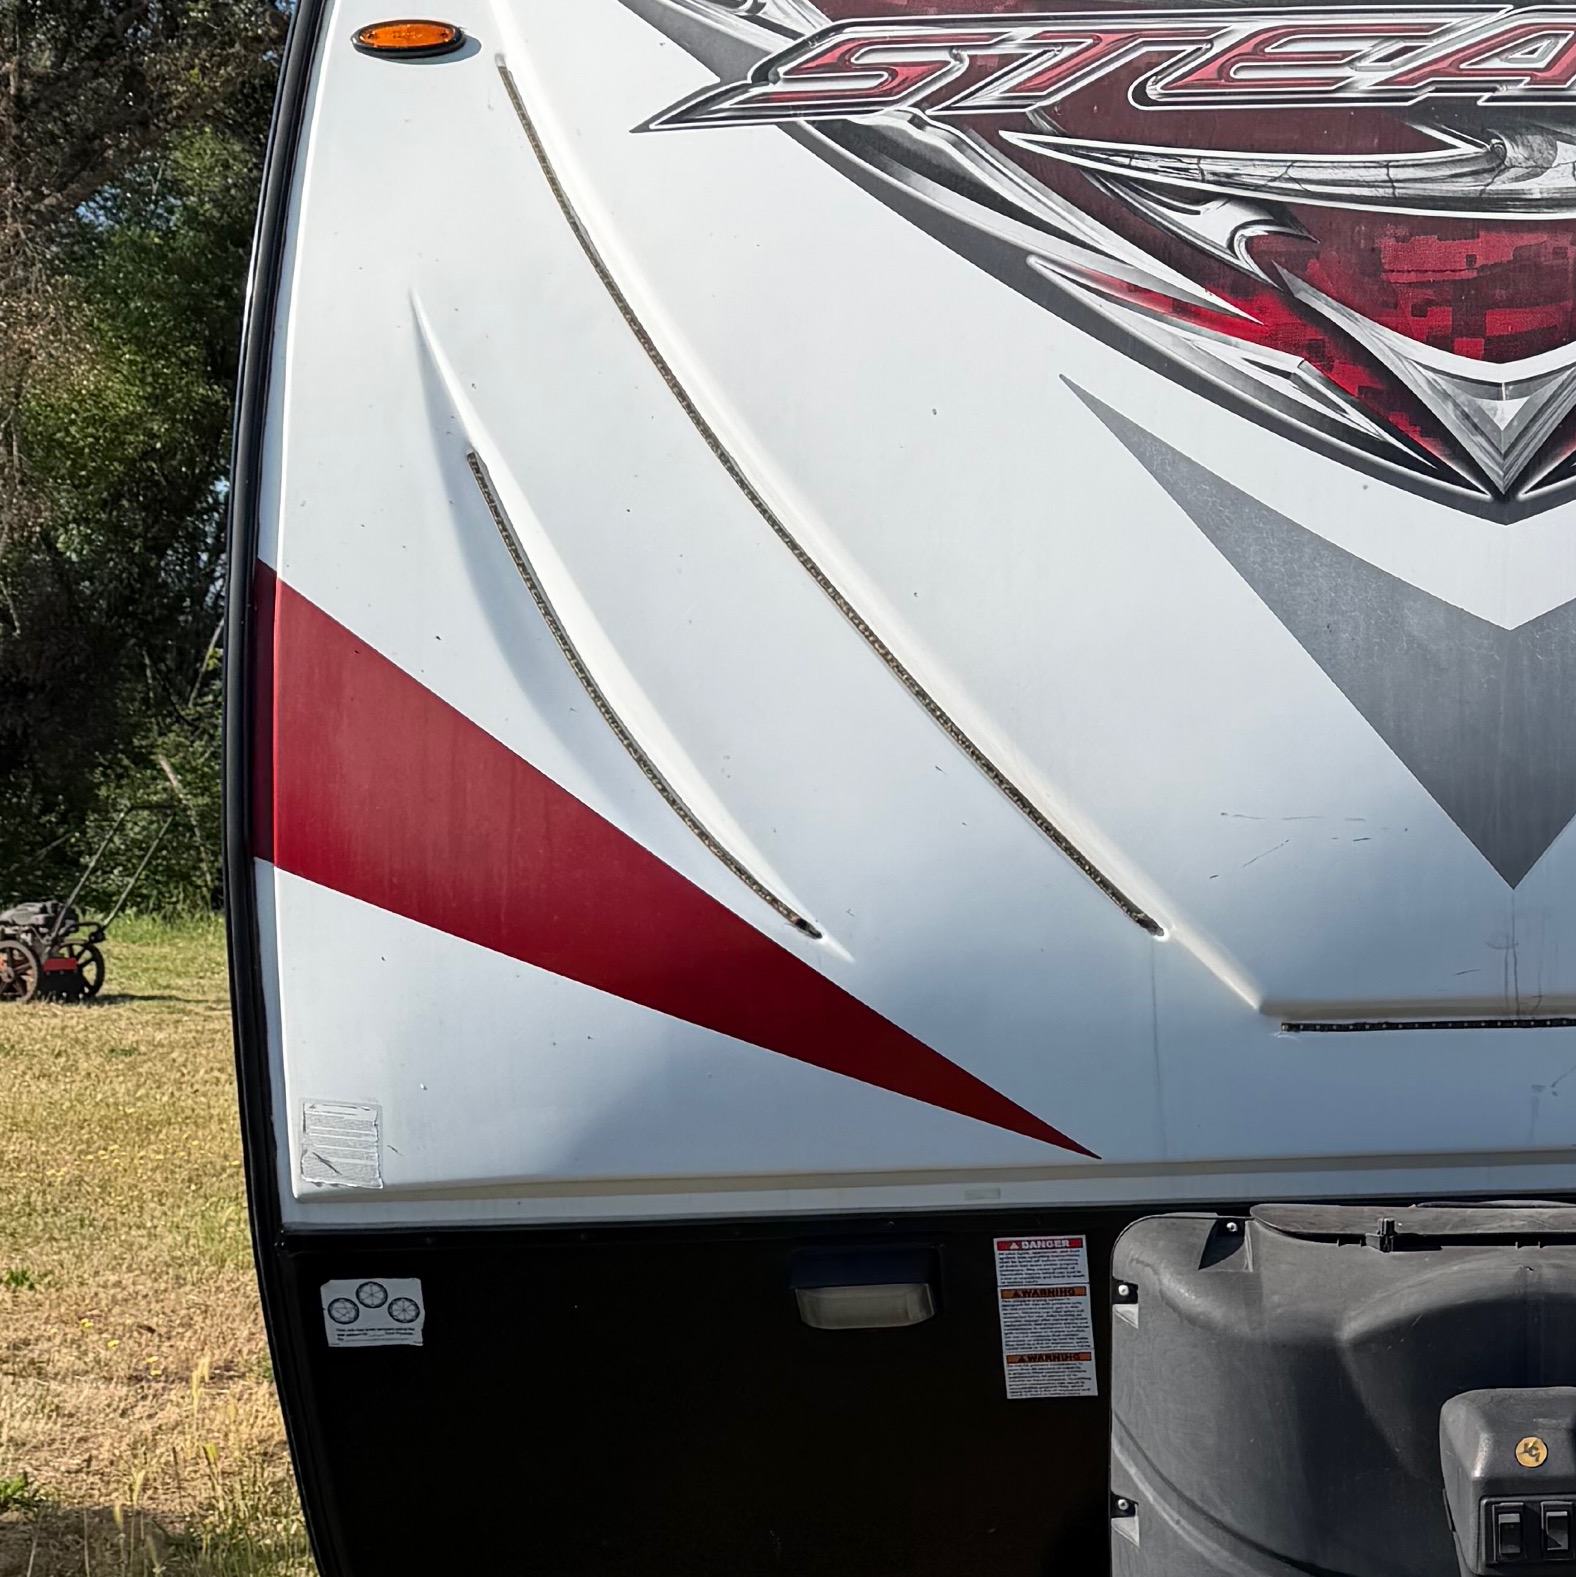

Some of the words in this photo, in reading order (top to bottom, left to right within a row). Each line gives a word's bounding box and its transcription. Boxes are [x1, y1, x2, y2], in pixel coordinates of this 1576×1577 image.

[1021, 1239, 1070, 1249] DANGER
[1022, 1287, 1075, 1297] WARNING
[1027, 1352, 1081, 1363] WARNING
